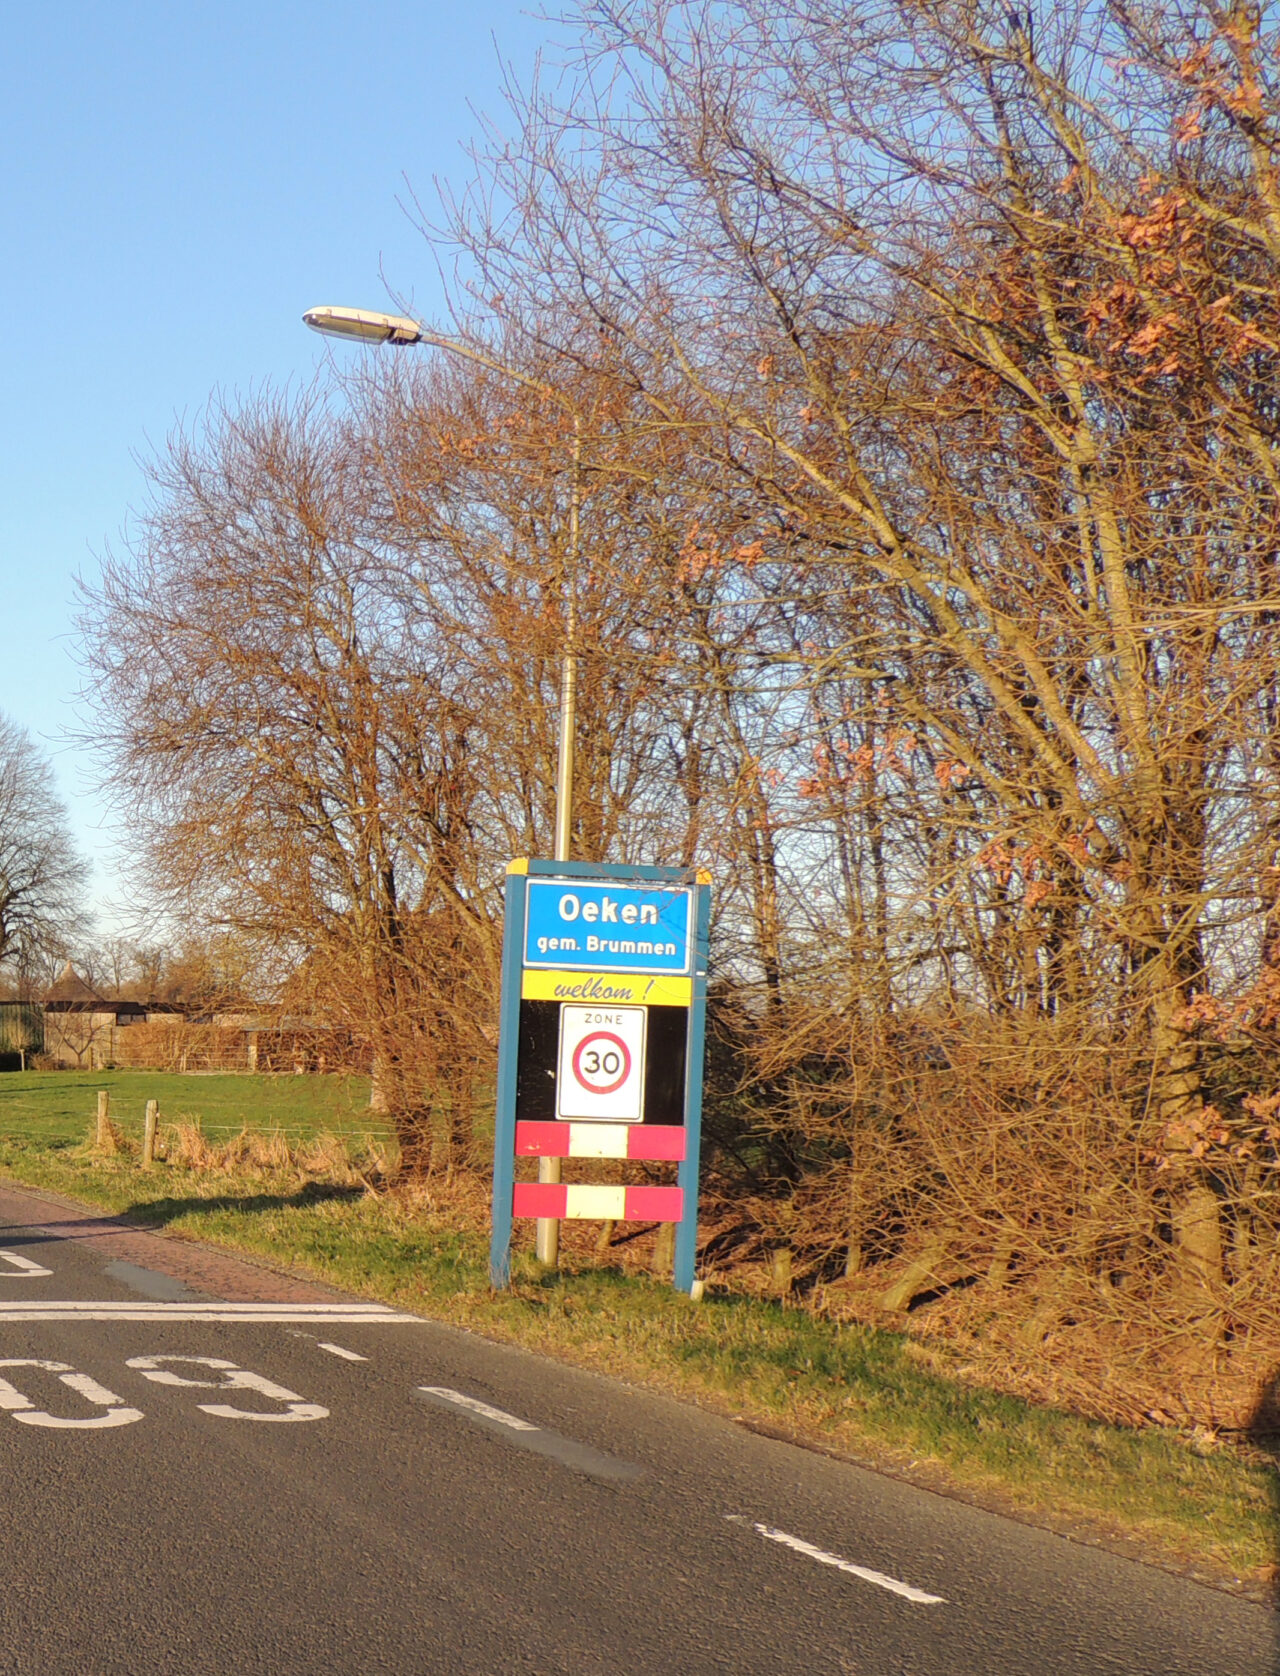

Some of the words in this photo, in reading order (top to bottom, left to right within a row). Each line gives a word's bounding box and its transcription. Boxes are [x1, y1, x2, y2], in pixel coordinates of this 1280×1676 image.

[558, 894, 659, 925] Oeken
[536, 936, 582, 954] gem.
[586, 936, 676, 956] Brummen
[553, 977, 634, 1001] welkom
[584, 1013, 624, 1025] ZONE
[583, 1051, 620, 1075] 30
